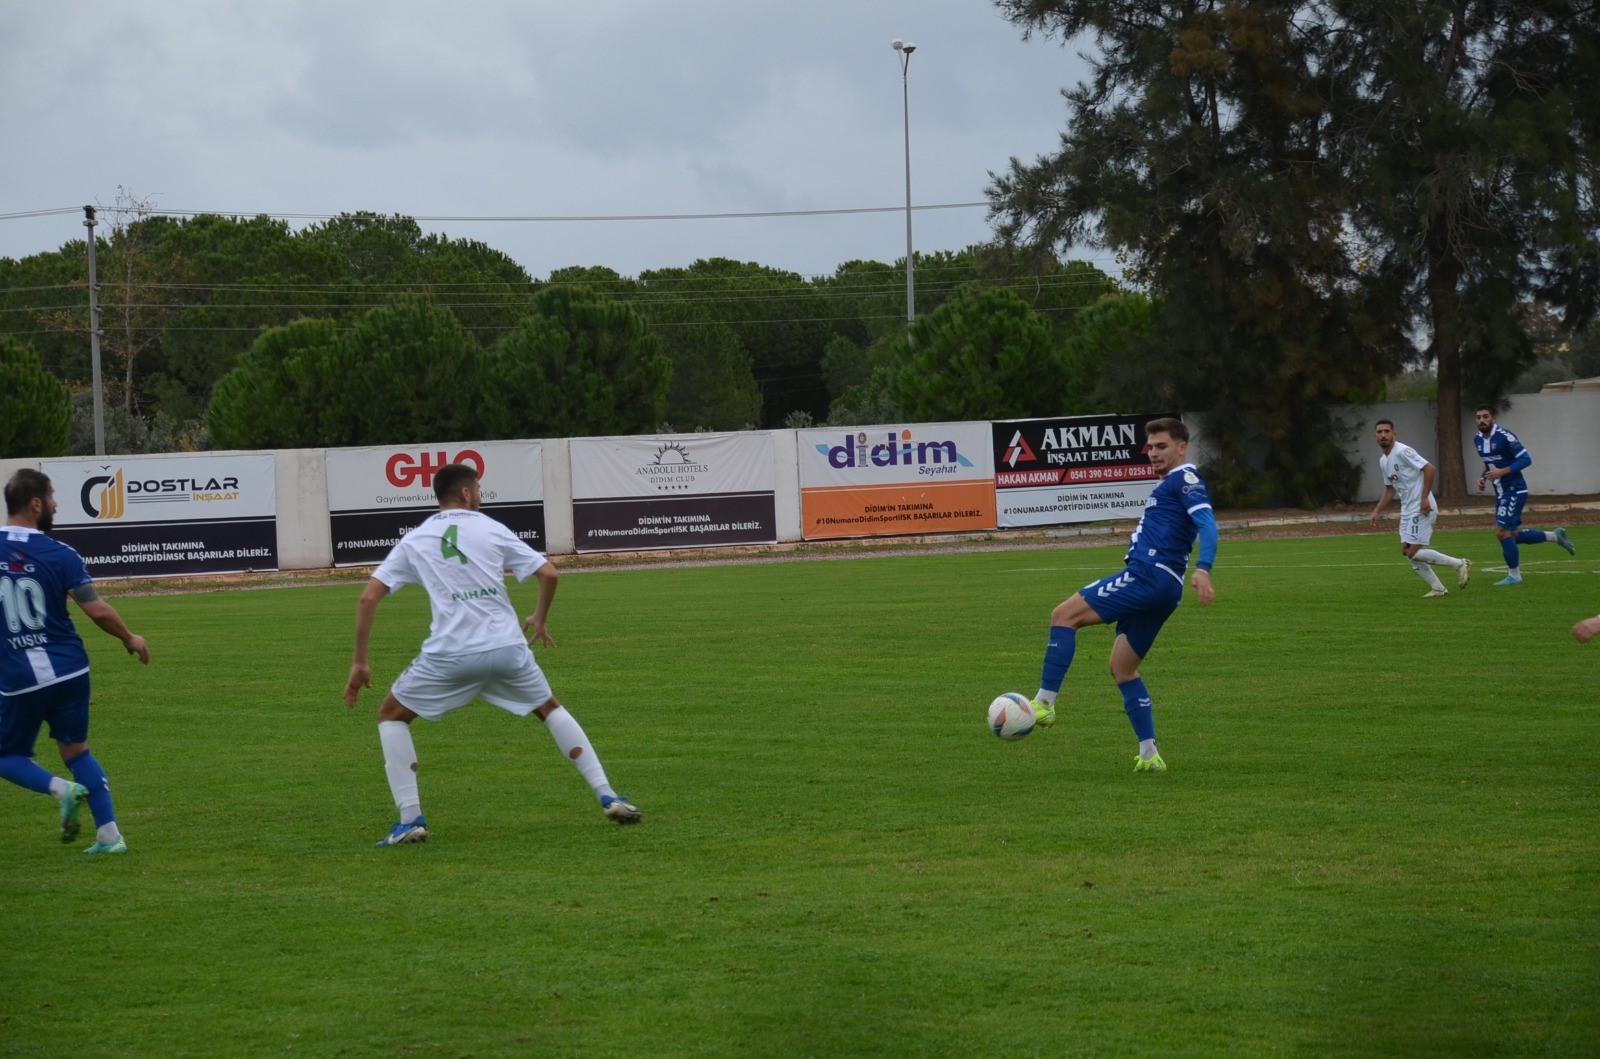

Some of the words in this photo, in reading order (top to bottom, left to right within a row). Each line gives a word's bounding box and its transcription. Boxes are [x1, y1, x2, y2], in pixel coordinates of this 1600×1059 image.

[1040, 424, 1137, 450] AKMAN
[828, 429, 957, 469] didim
[1047, 451, 1088, 466] İNŞAAT
[1091, 449, 1131, 461] EMLAK
[635, 466, 677, 475] ANADOLU
[678, 464, 709, 473] HOTELS
[918, 464, 957, 477] Seyahat
[1070, 470, 1087, 480] 0541
[1088, 469, 1102, 479] 390
[1103, 468, 1113, 478] 42
[1113, 468, 1123, 477] 66
[1128, 466, 1146, 476] 0256
[675, 475, 696, 483] CLUB
[998, 473, 1027, 485] HAKAN
[1028, 471, 1059, 483] AKMAN
[127, 476, 239, 494] DOSTLAR
[192, 490, 239, 503] İNŞAAT
[375, 492, 429, 505] Gayrimenkul
[480, 491, 498, 499] klığı
[1057, 494, 1088, 503] DİDİM'İN
[1090, 491, 1125, 500] TAKIMINA
[864, 503, 896, 513] DİDİM'İN
[898, 502, 934, 511] TAKIMINA
[1111, 499, 1148, 509] BAŞARILA
[638, 515, 671, 525] DİDİM'İN
[673, 514, 711, 524] TAKIMINA
[913, 511, 952, 522] BAŞARILAR
[953, 508, 983, 518] DİLERİZ.
[689, 522, 730, 534] BAŞARILAR
[731, 520, 762, 530] DİLERİZ.
[121, 541, 160, 553] DİDİM'İN
[161, 541, 205, 551] TAKIMINA
[337, 538, 400, 550] #10NUMARASP
[440, 524, 469, 565] 4
[187, 548, 235, 561] BAŞARILAR
[236, 546, 272, 558] DİLERİZ.
[0, 575, 47, 634] 10
[7, 633, 49, 650] YUSUF
